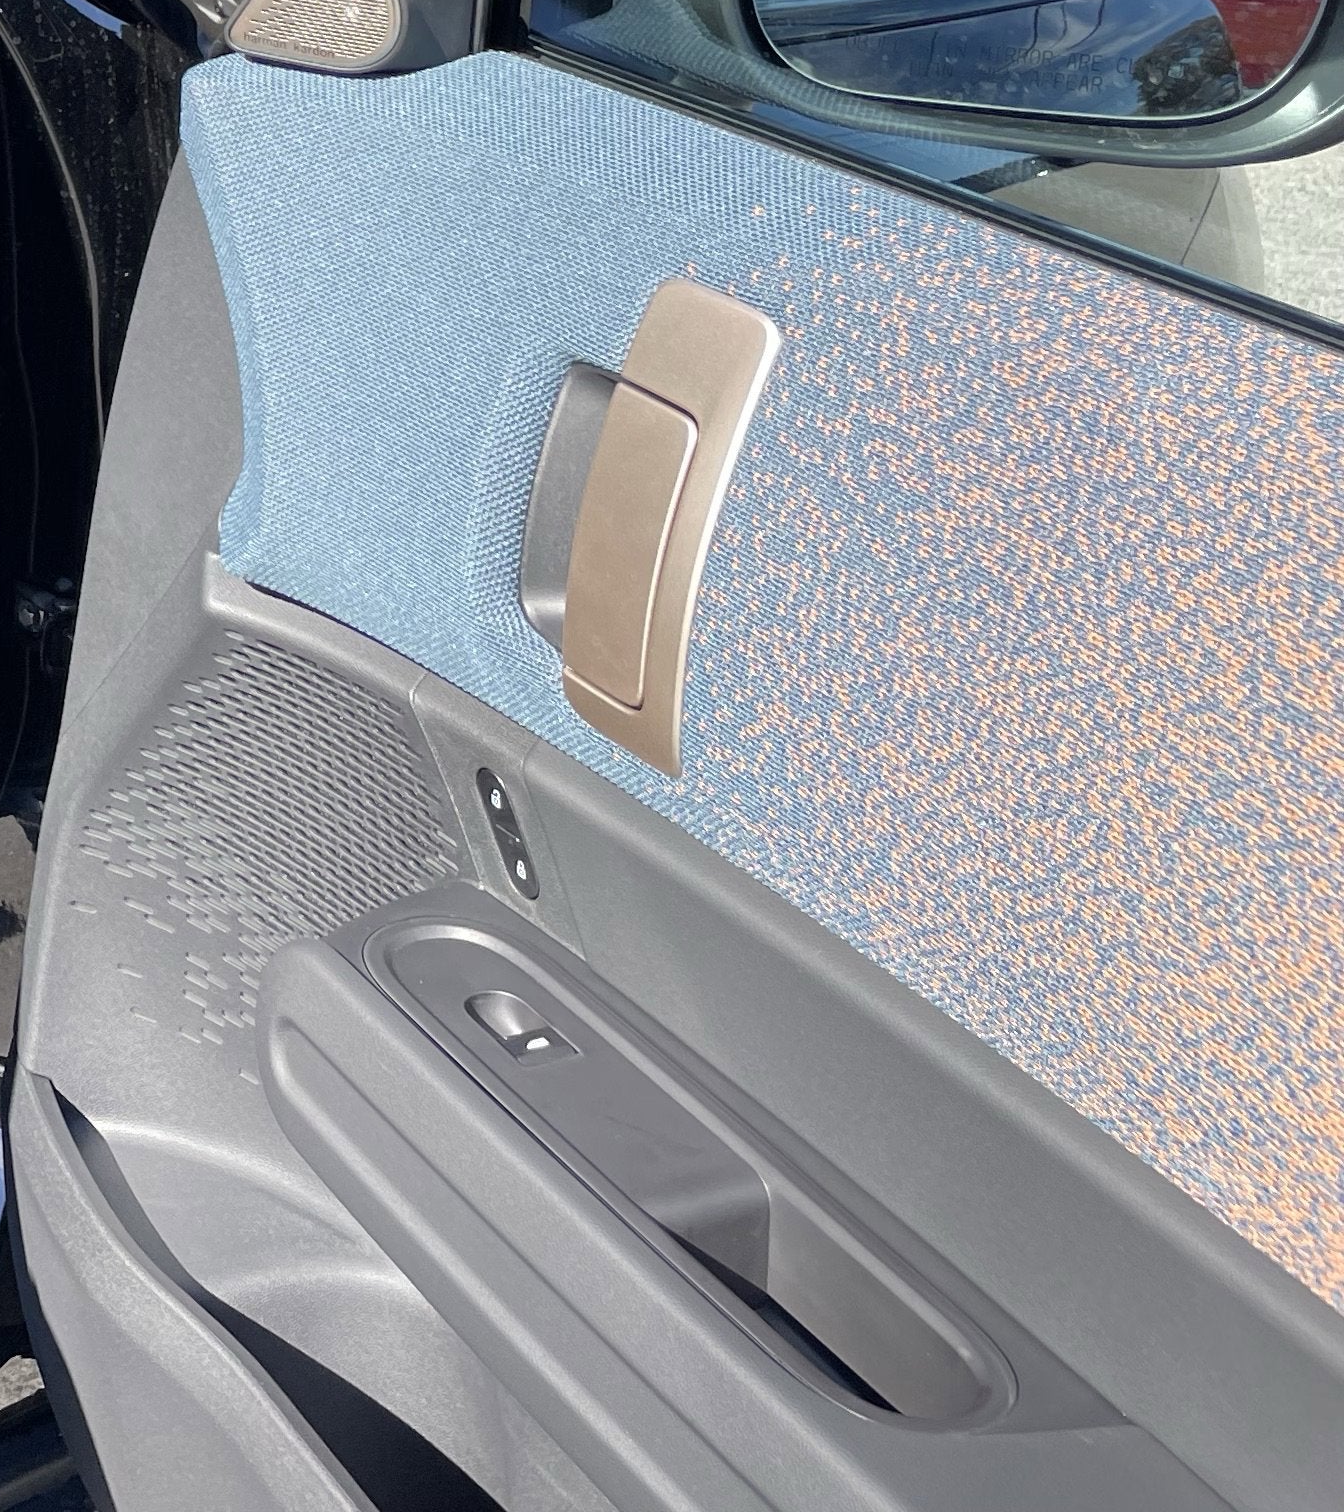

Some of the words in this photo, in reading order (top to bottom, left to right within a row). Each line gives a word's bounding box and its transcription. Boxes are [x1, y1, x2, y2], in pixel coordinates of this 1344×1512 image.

[243, 32, 287, 49] harman
[293, 42, 335, 58] kardon
[1067, 52, 1104, 73] ARE
